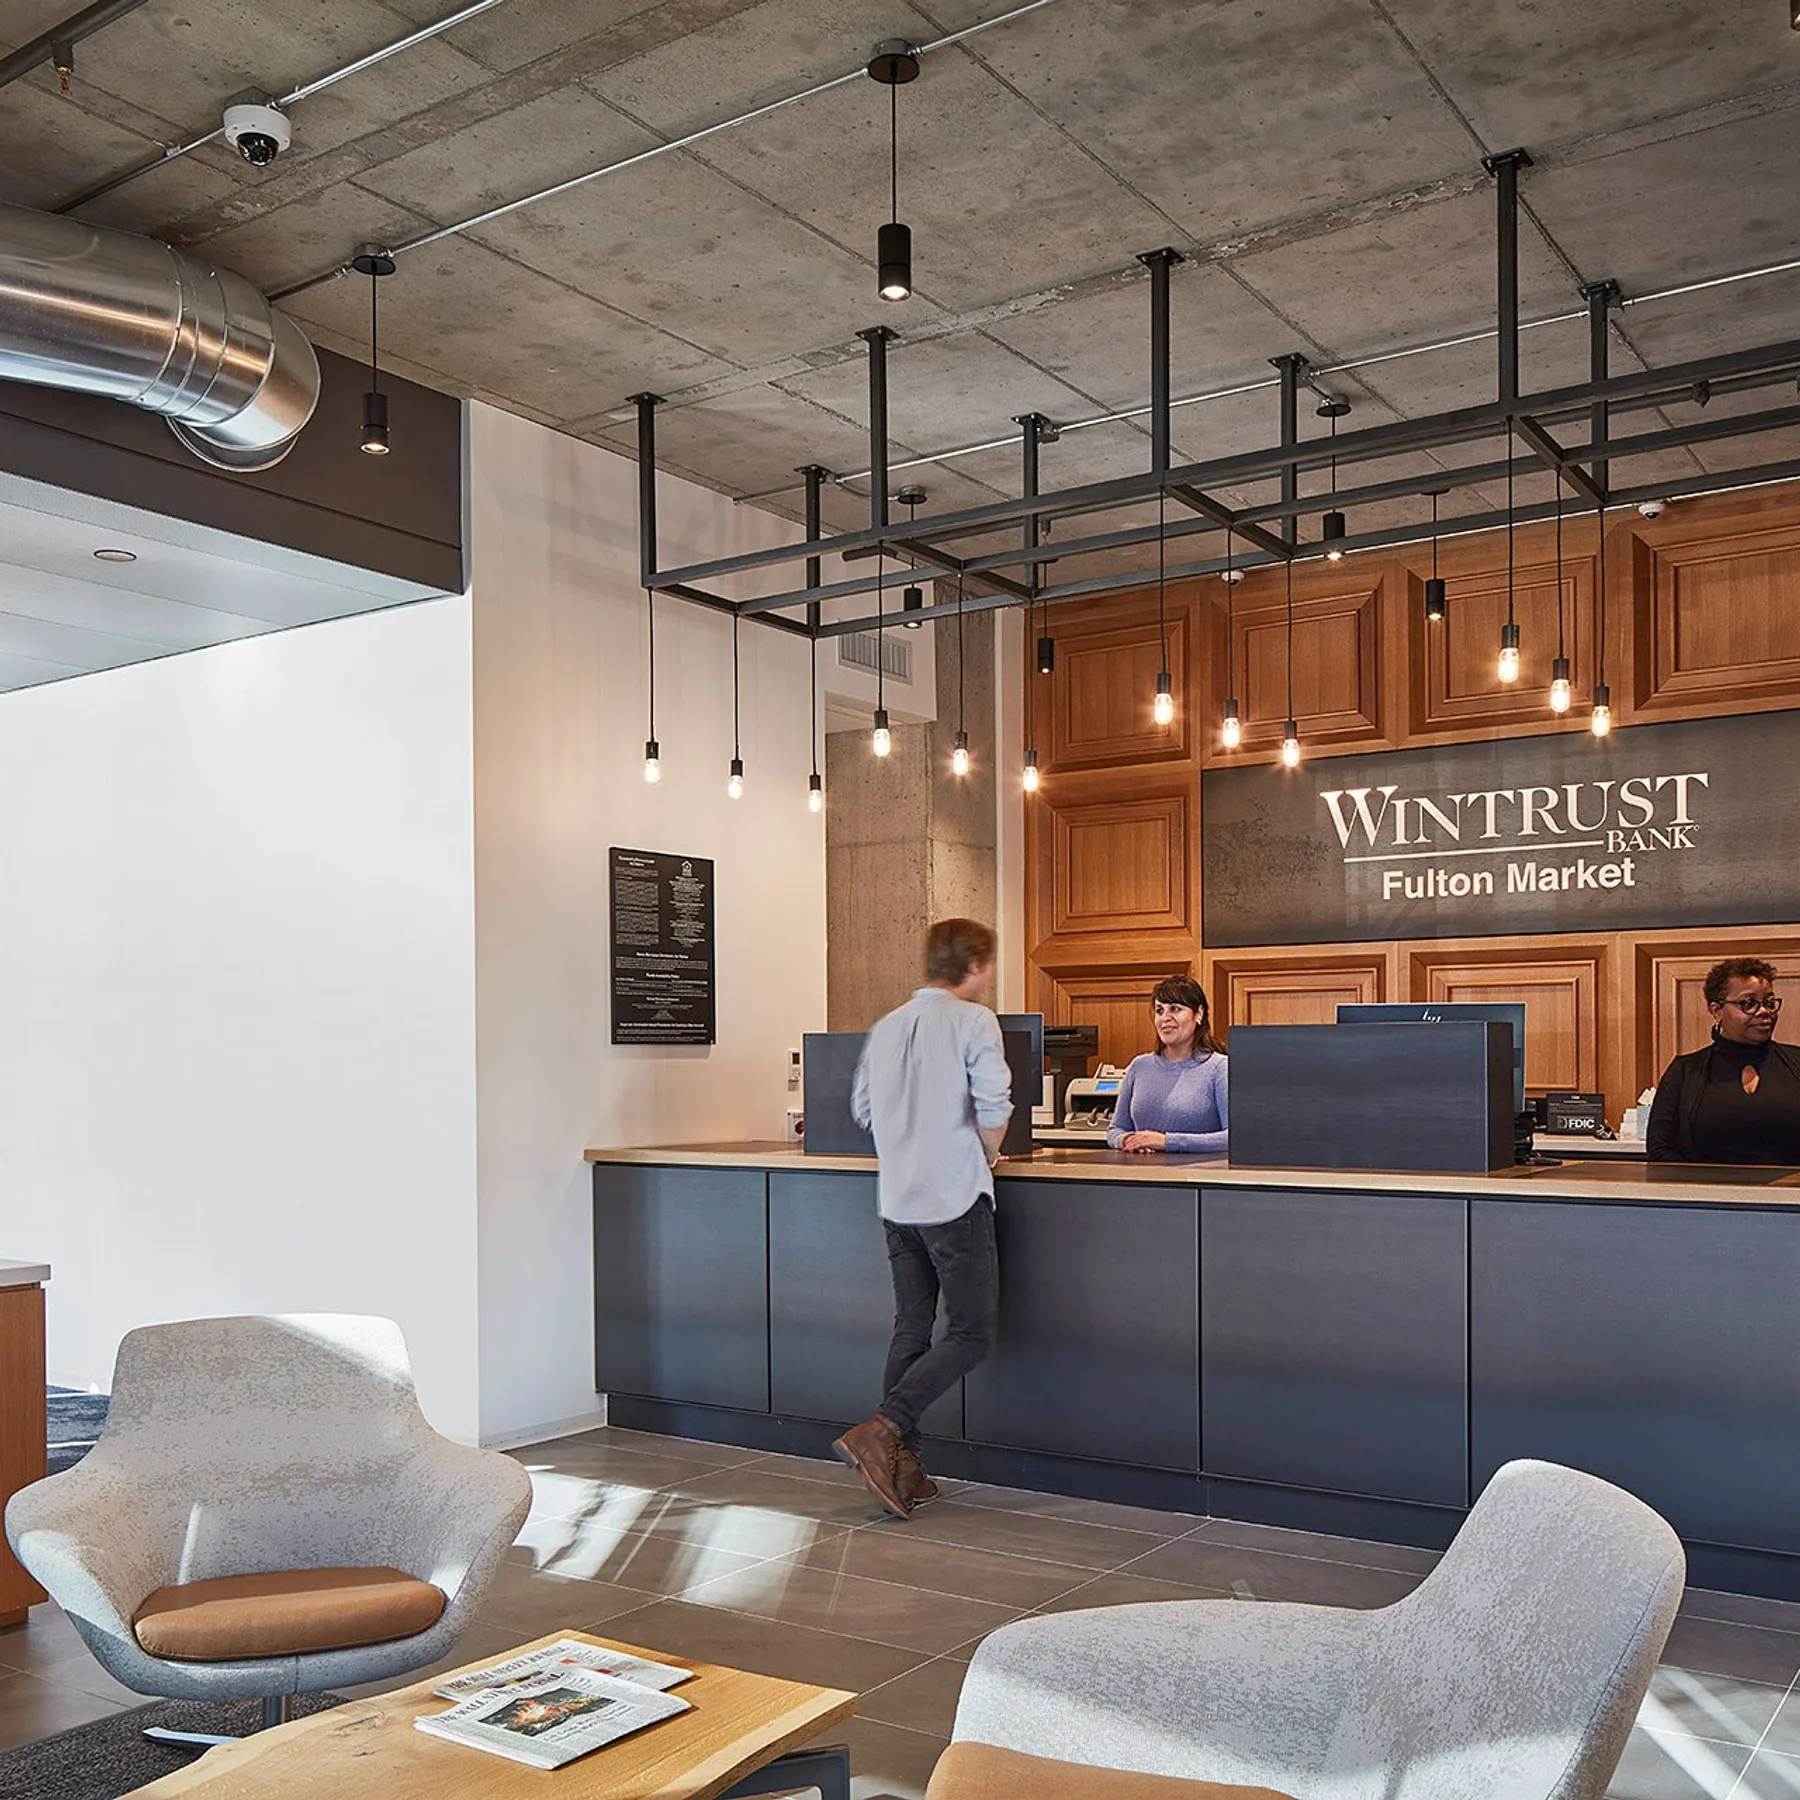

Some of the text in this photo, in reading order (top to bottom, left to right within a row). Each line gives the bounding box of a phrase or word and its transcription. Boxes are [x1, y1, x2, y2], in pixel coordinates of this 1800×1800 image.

[1319, 772, 1710, 850] WINTRUST
[1382, 857, 1637, 901] Fulton Market
[1569, 1118, 1595, 1129] FDIC
